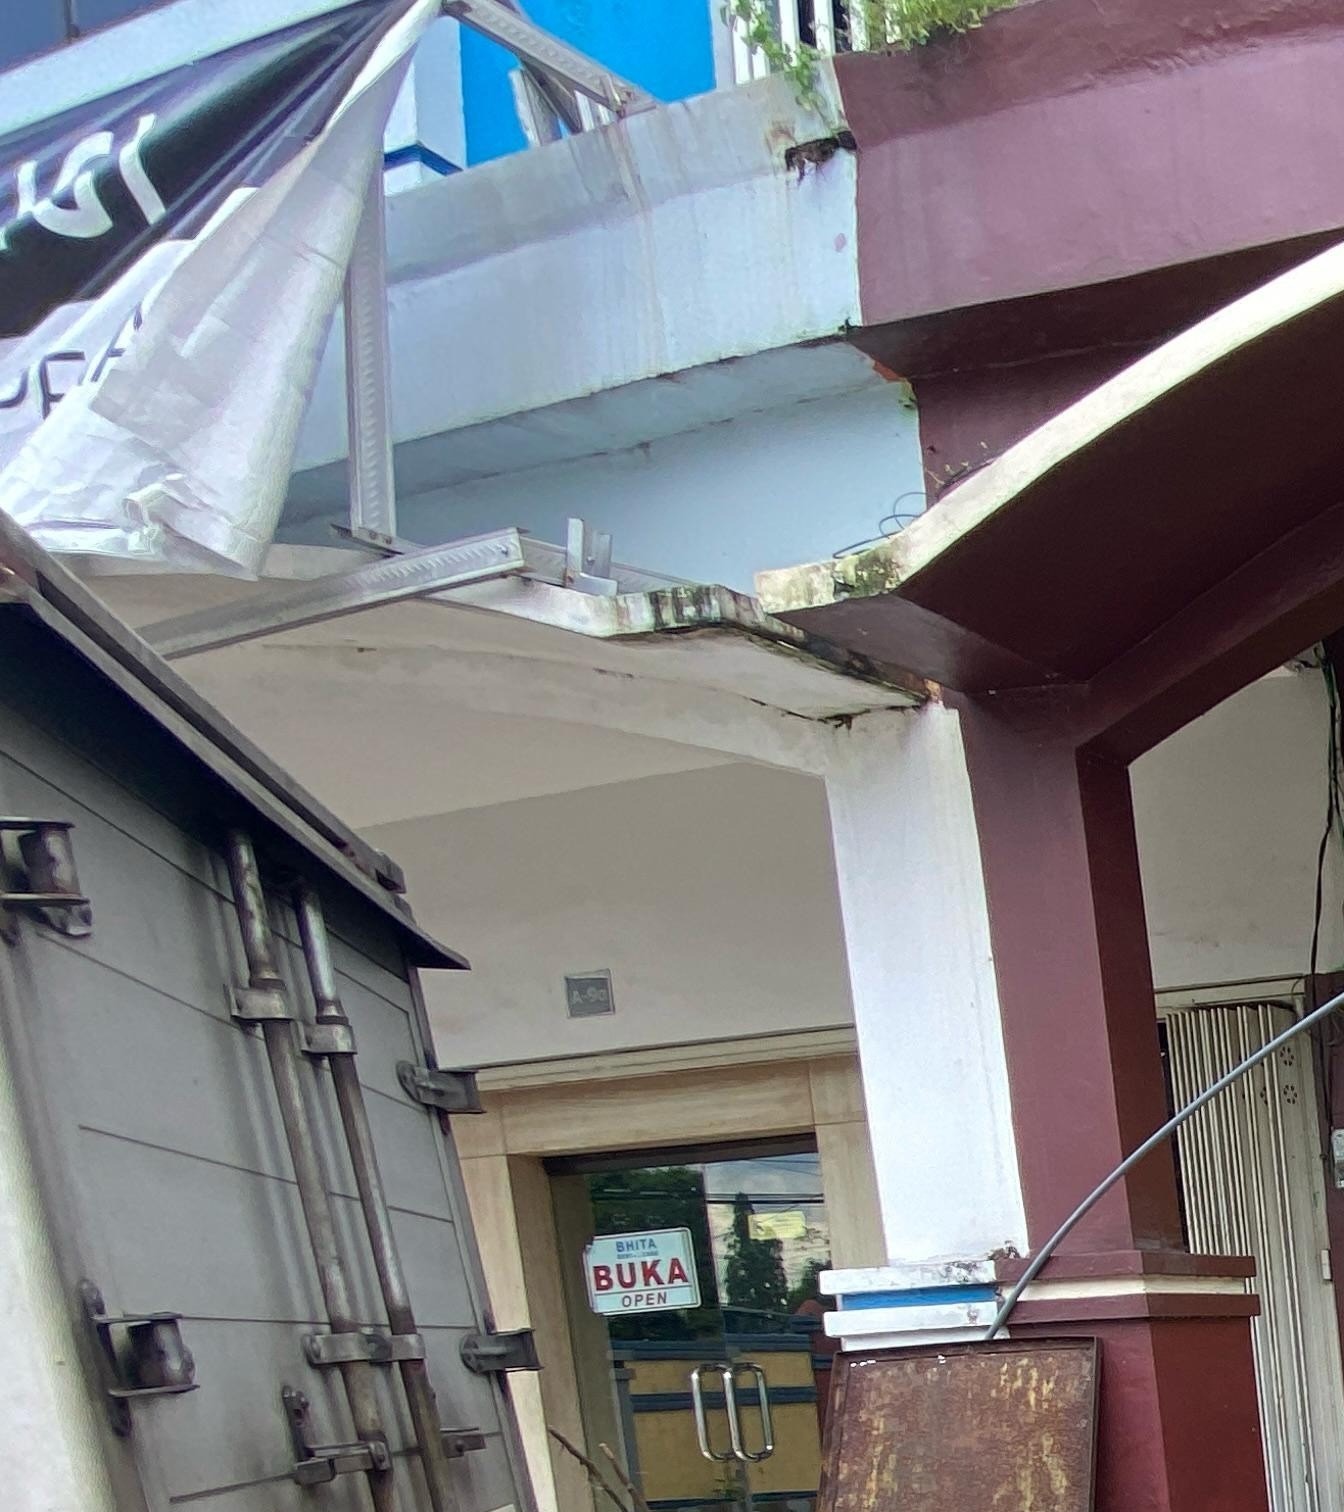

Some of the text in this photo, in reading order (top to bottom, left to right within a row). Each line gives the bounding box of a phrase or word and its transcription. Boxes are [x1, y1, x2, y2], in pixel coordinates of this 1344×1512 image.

[616, 1238, 657, 1253] BHITA
[593, 1258, 689, 1291] BUKA
[622, 1293, 667, 1308] OPEN
